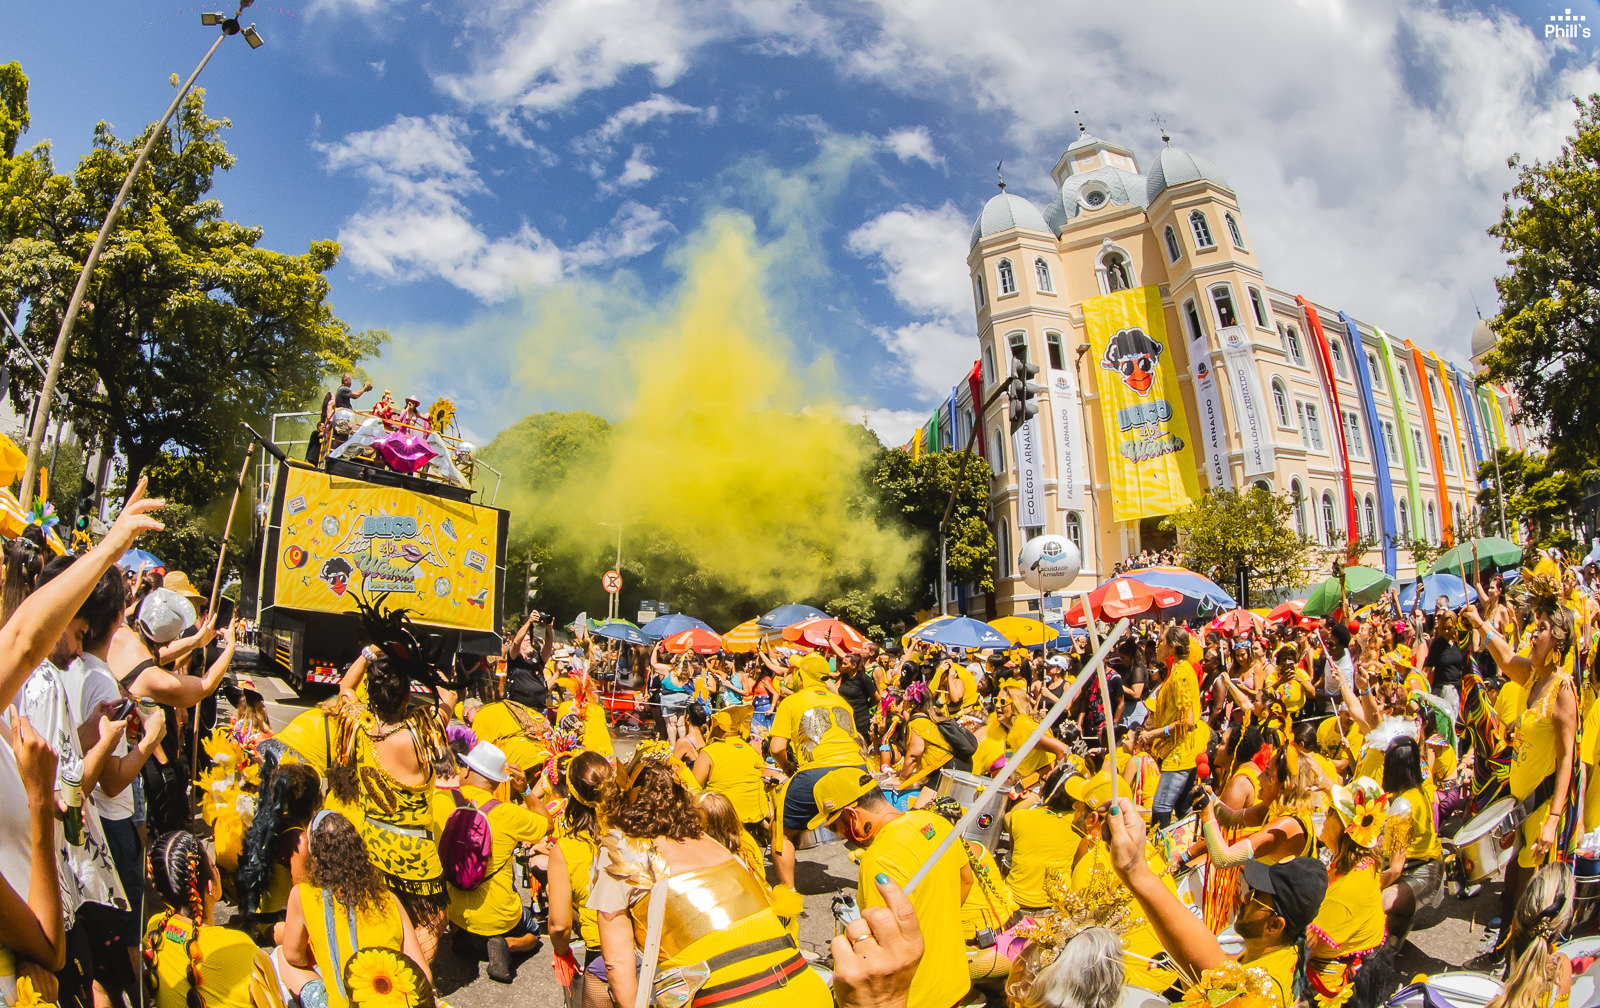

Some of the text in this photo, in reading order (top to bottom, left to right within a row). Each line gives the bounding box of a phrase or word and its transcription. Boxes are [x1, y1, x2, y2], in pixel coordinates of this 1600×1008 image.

[1062, 409, 1071, 448] ARNALDO
[1205, 398, 1219, 448] ARNALDO
[1238, 369, 1262, 466] FACULDADE ARNALDO
[1024, 469, 1035, 515] COLÉGIO
[1064, 450, 1073, 499] FACULDADE
[1213, 453, 1224, 489] LÉGIO
